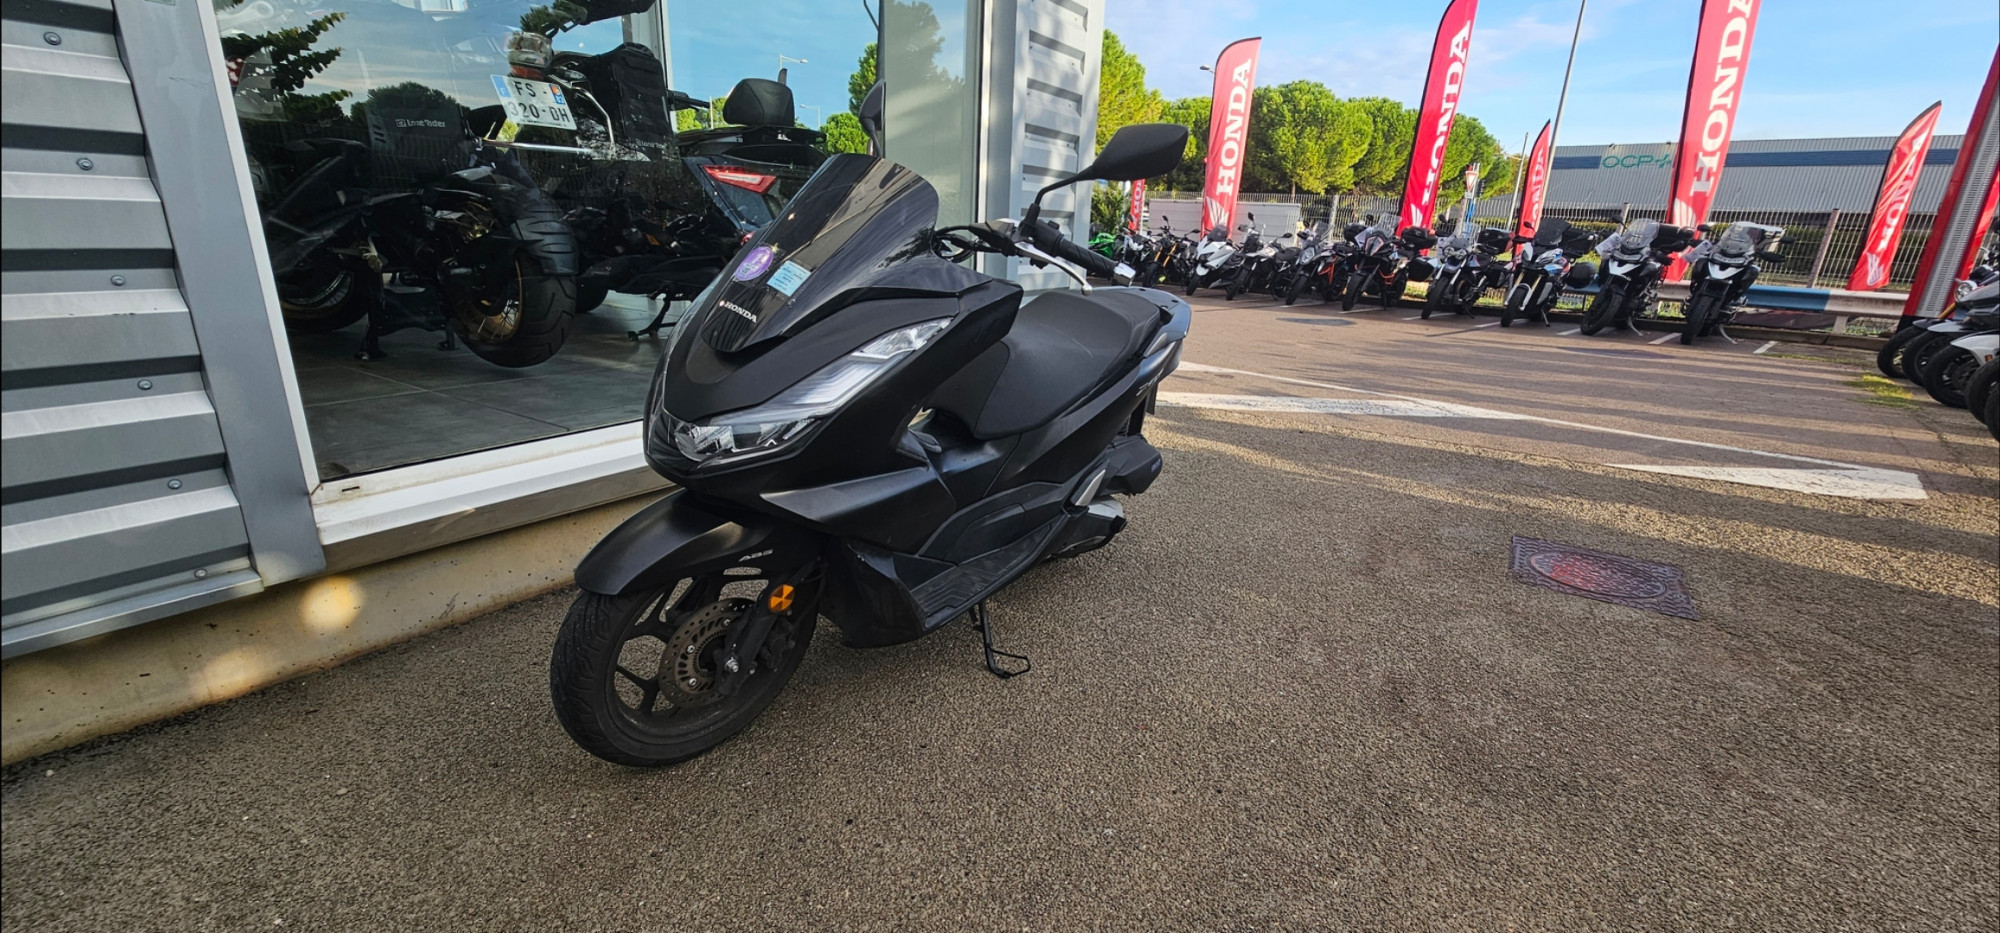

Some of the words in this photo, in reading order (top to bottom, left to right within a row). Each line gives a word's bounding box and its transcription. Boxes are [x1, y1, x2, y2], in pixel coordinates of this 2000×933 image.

[508, 102, 570, 122] 320-DH
[1216, 58, 1252, 196] HONDA
[724, 301, 757, 323] HONDA
